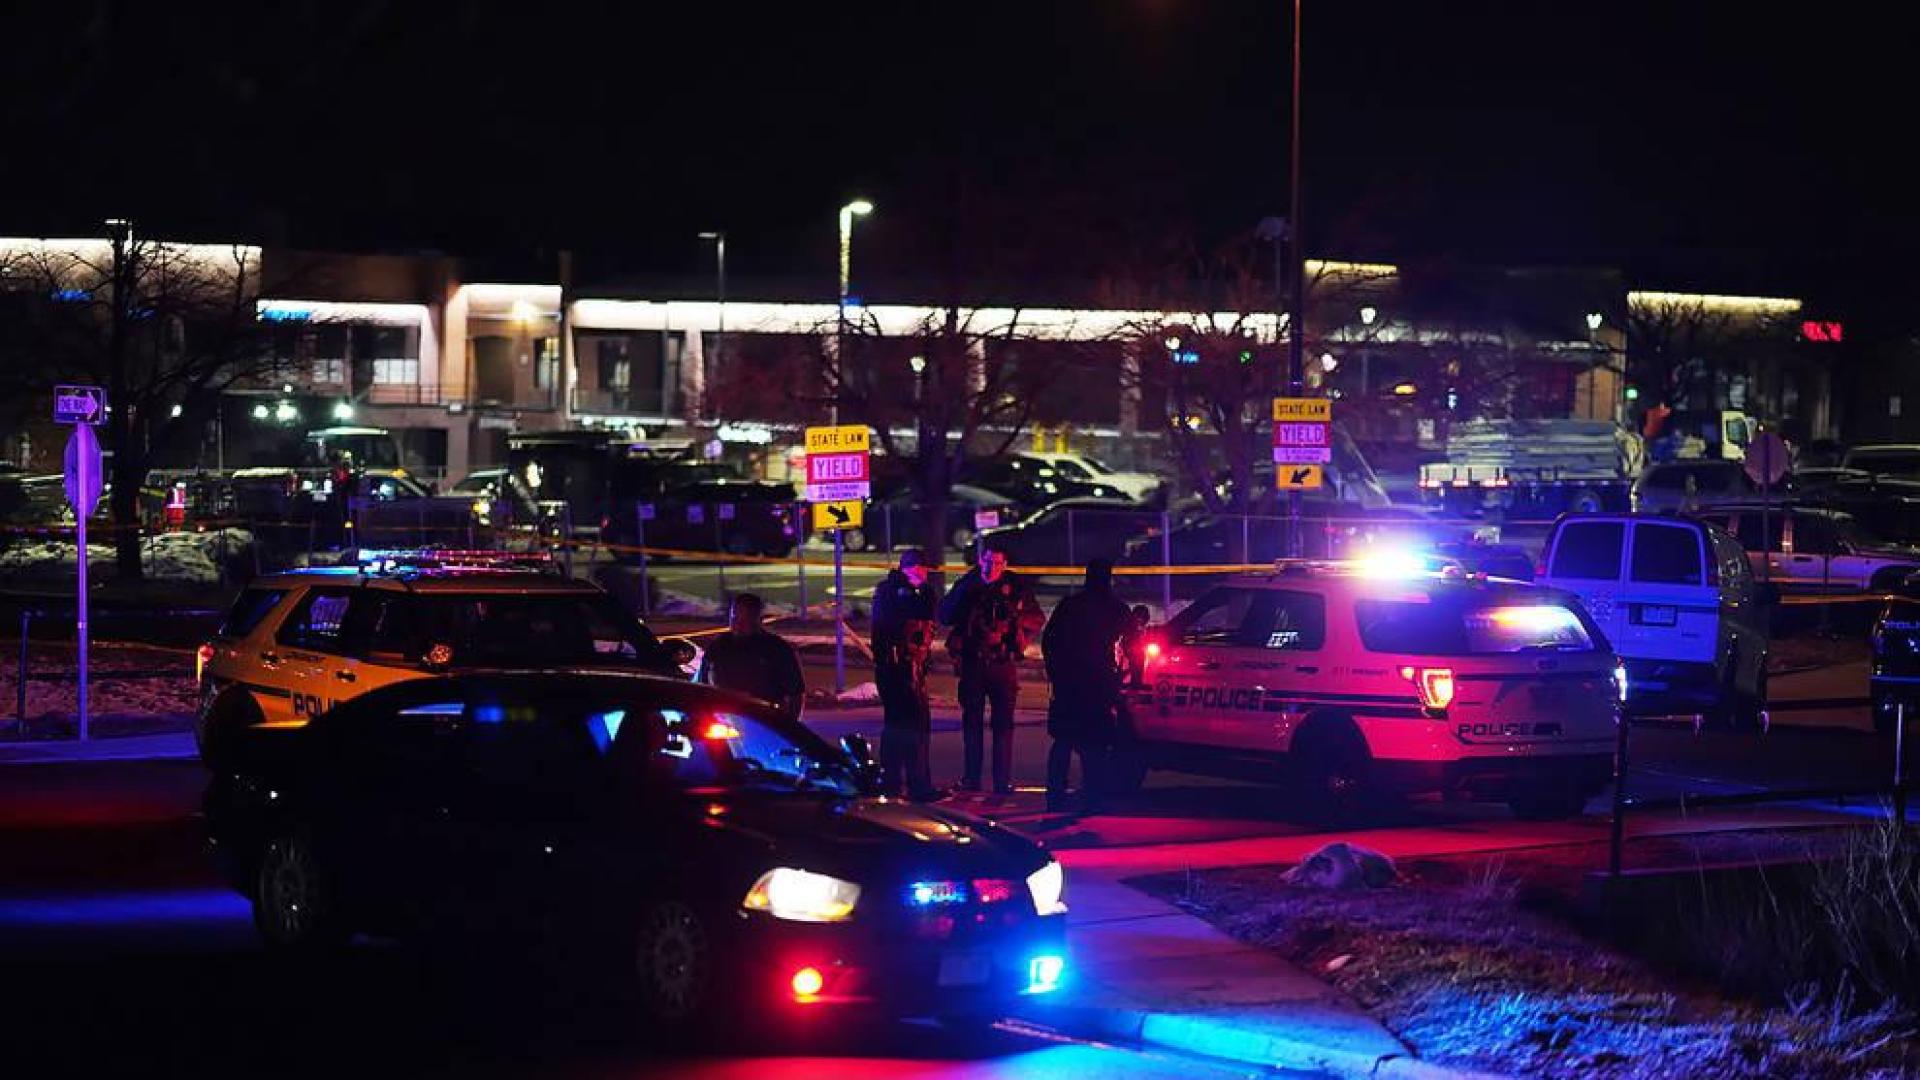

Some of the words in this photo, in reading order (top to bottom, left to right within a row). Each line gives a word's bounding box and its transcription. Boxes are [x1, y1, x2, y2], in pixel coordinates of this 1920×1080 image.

[1279, 404, 1303, 416] STATE
[1308, 404, 1326, 415] LAW
[811, 433, 839, 446] STATE
[844, 432, 863, 444] LAW
[1283, 426, 1322, 442] YIELD
[816, 457, 861, 477] YIELD
[1190, 687, 1261, 712] POLICE
[1458, 722, 1531, 737] POLICE
